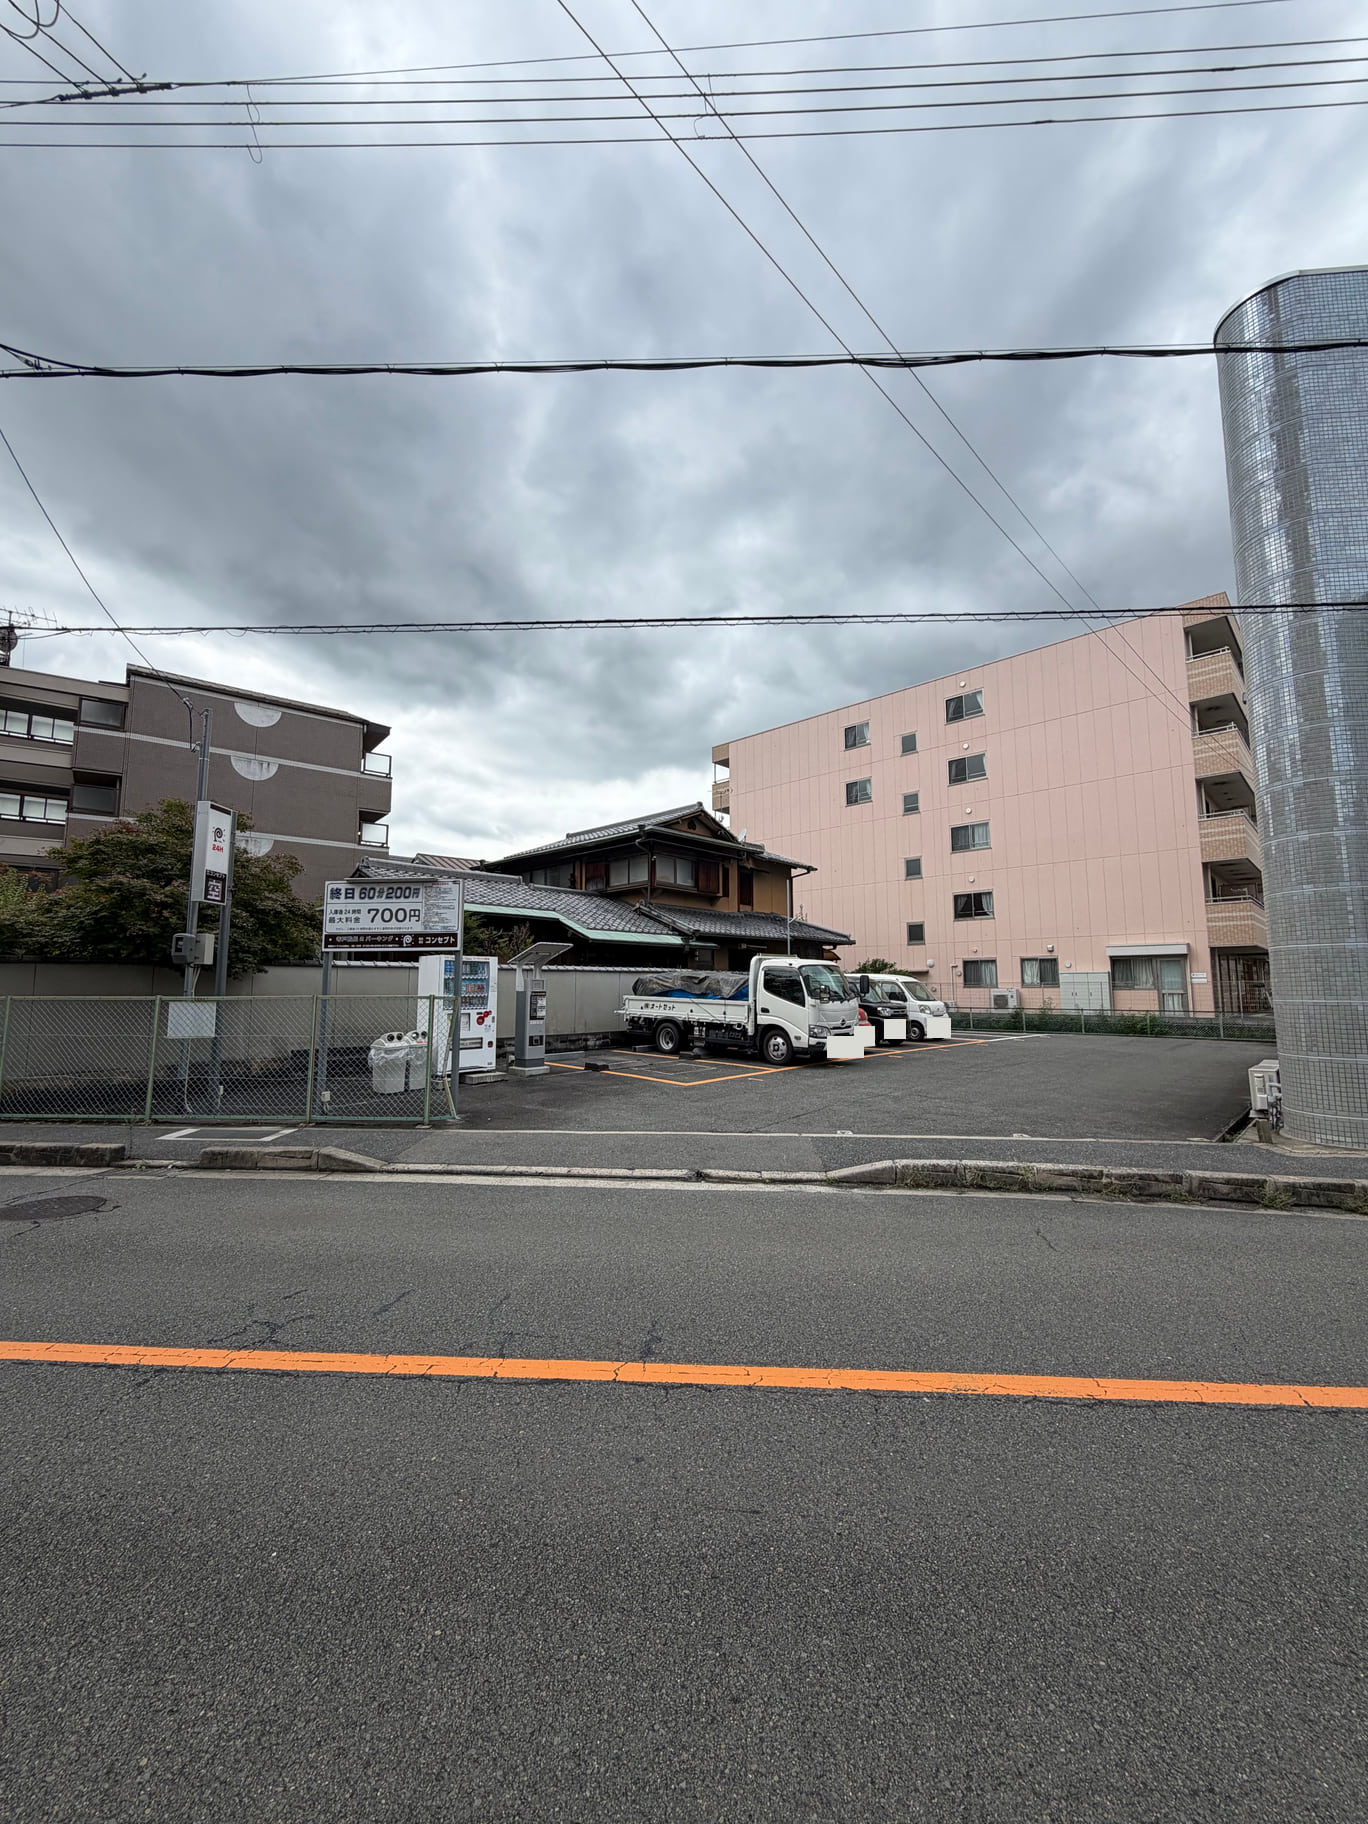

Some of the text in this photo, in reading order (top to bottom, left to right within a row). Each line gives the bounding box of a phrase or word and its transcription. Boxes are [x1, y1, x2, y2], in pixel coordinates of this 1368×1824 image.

[212, 844, 224, 853] 24H
[207, 880, 221, 900] 空
[330, 887, 420, 900] 終日 60分200円
[367, 908, 421, 923] 700円
